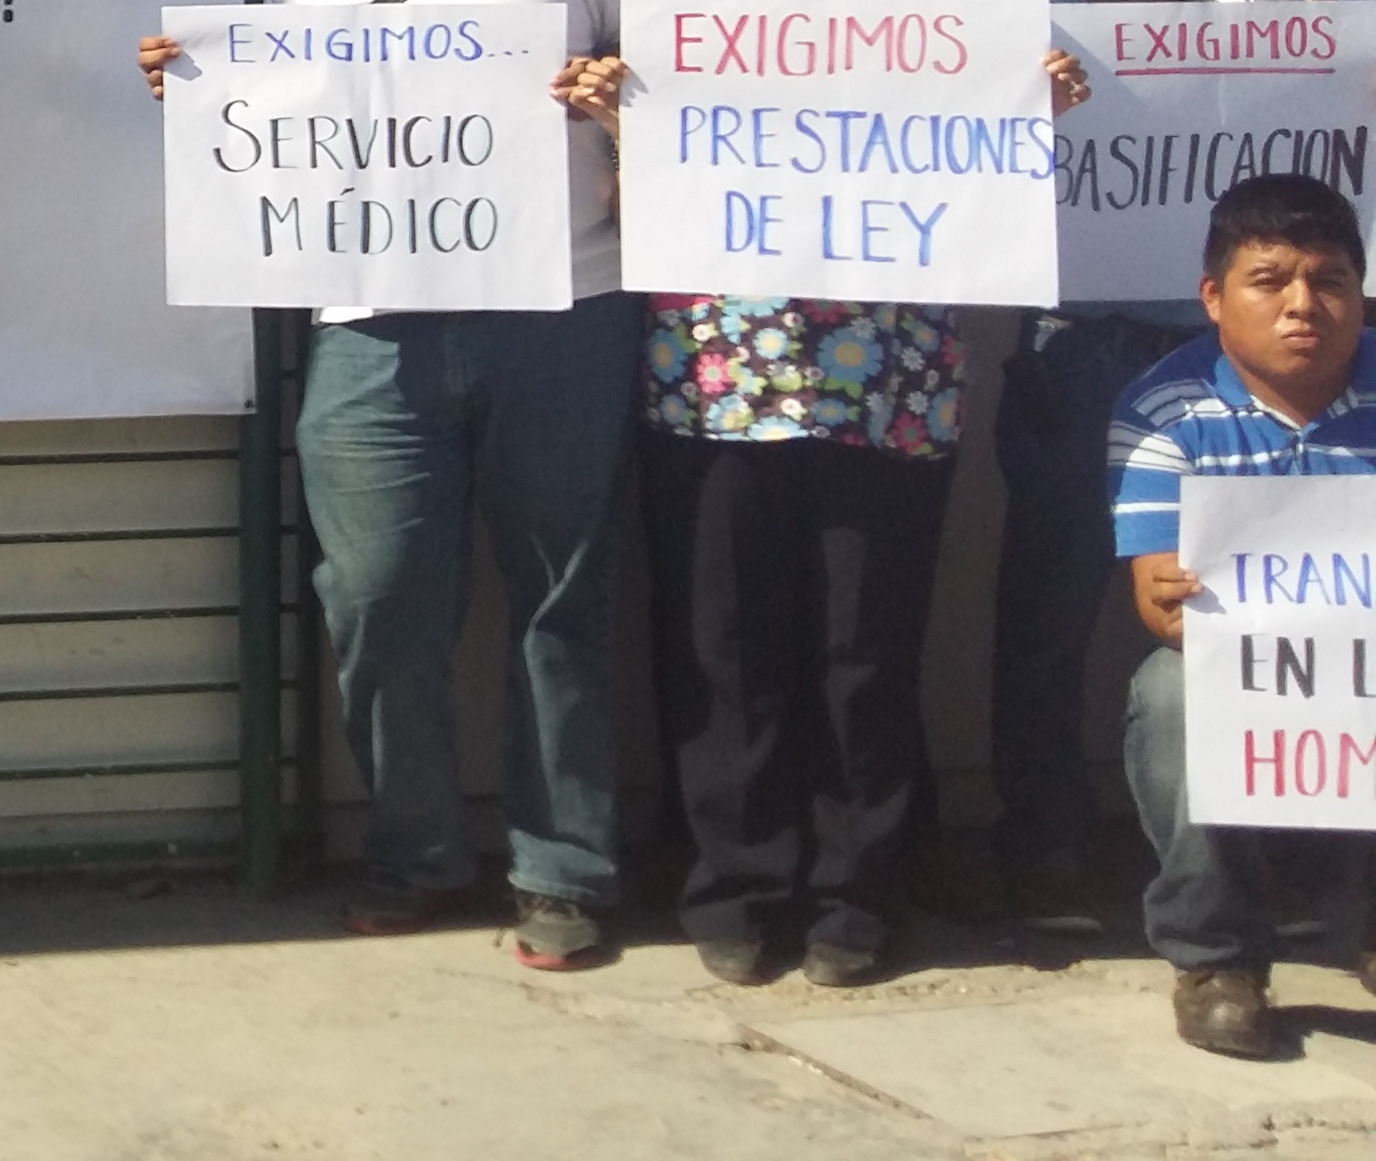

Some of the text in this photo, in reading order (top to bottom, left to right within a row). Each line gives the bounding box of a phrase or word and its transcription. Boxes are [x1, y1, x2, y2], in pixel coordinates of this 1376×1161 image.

[673, 12, 968, 77] EXIGIMOS
[1115, 16, 1336, 62] EXIGIMOS
[212, 99, 494, 173] SERVICIO
[679, 105, 1055, 180] PRESTACIONES
[260, 187, 498, 257] MÉDICO
[725, 191, 949, 267] DE LEY
[1240, 633, 1315, 699] EN
